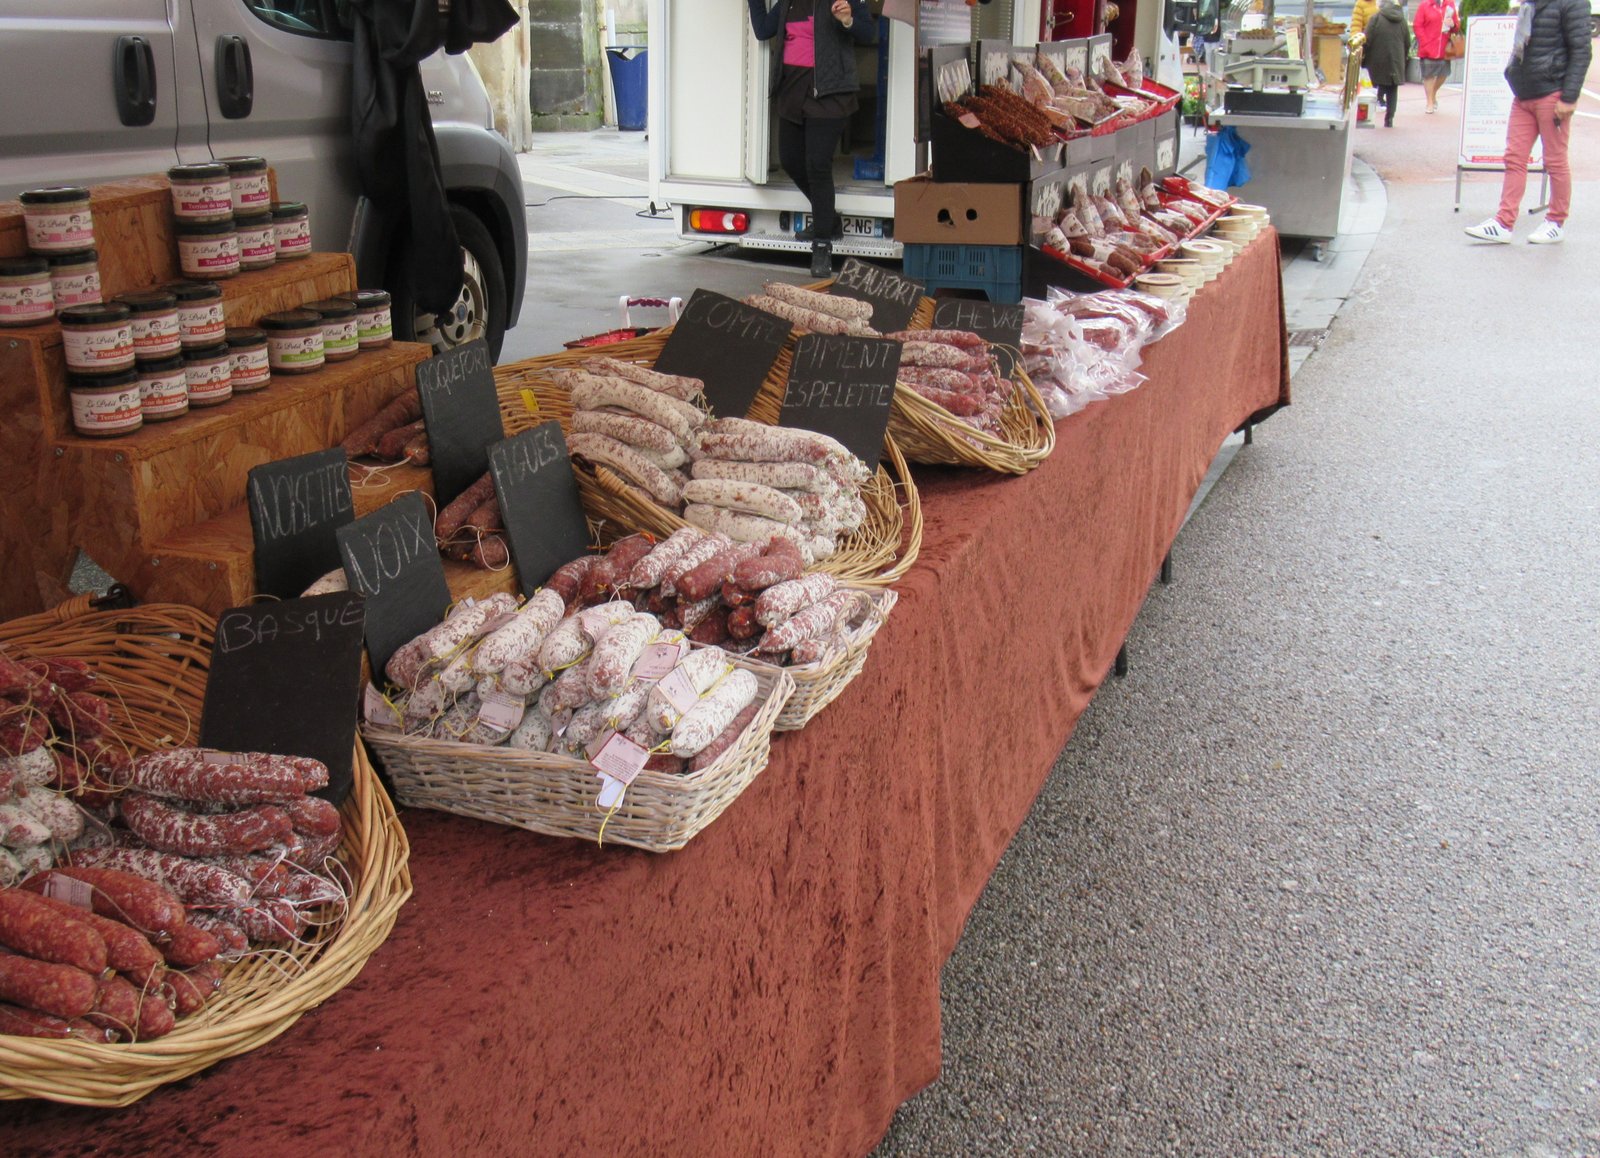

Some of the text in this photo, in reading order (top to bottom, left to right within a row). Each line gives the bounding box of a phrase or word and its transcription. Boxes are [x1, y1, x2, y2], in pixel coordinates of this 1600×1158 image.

[48, 219, 67, 228] Petit
[284, 227, 299, 235] Petit
[200, 246, 218, 255] Petit
[206, 258, 226, 266] Terrine
[64, 280, 83, 290] Petit
[837, 258, 925, 307] BEAUFORT
[190, 312, 208, 321] Petit
[192, 326, 213, 334] Terrine
[326, 329, 342, 337] Petit
[85, 336, 116, 346] Le Petit
[154, 337, 163, 345] de
[284, 342, 301, 350] Petit
[100, 350, 122, 358] Terrine
[794, 335, 896, 377] PIMENT
[189, 371, 208, 380] Petit
[193, 383, 215, 392] Terrine
[783, 379, 890, 408] ESPELETTE
[86, 399, 116, 408] Le Petit
[100, 412, 123, 421] Terrine
[491, 429, 560, 508] FIGUES
[253, 462, 352, 544] NOISETTES
[345, 513, 432, 595] NOIX
